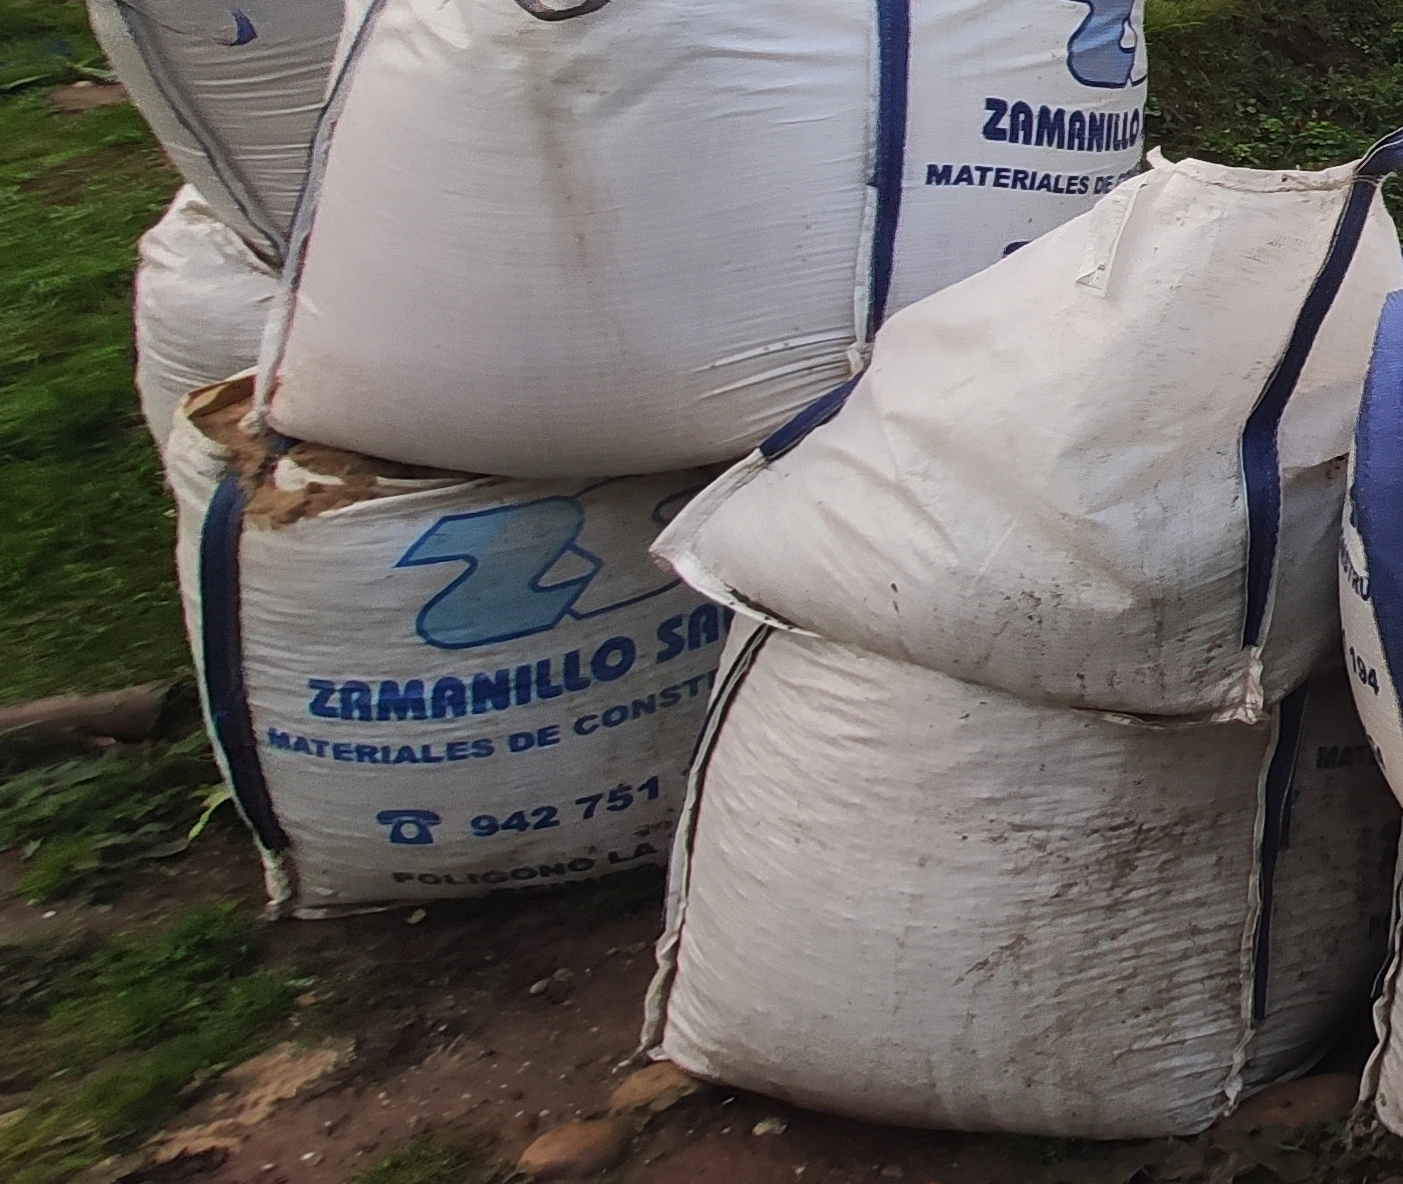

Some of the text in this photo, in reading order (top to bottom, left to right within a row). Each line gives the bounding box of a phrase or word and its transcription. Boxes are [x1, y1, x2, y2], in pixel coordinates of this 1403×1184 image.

[982, 97, 1140, 153] ZAMANILLO
[925, 164, 1090, 195] MATERIALES
[308, 635, 637, 722] ZAMANILLO
[267, 726, 496, 765] MATERIALES
[508, 724, 562, 753] DE
[470, 775, 660, 837] 942 751
[607, 842, 658, 865] LA
